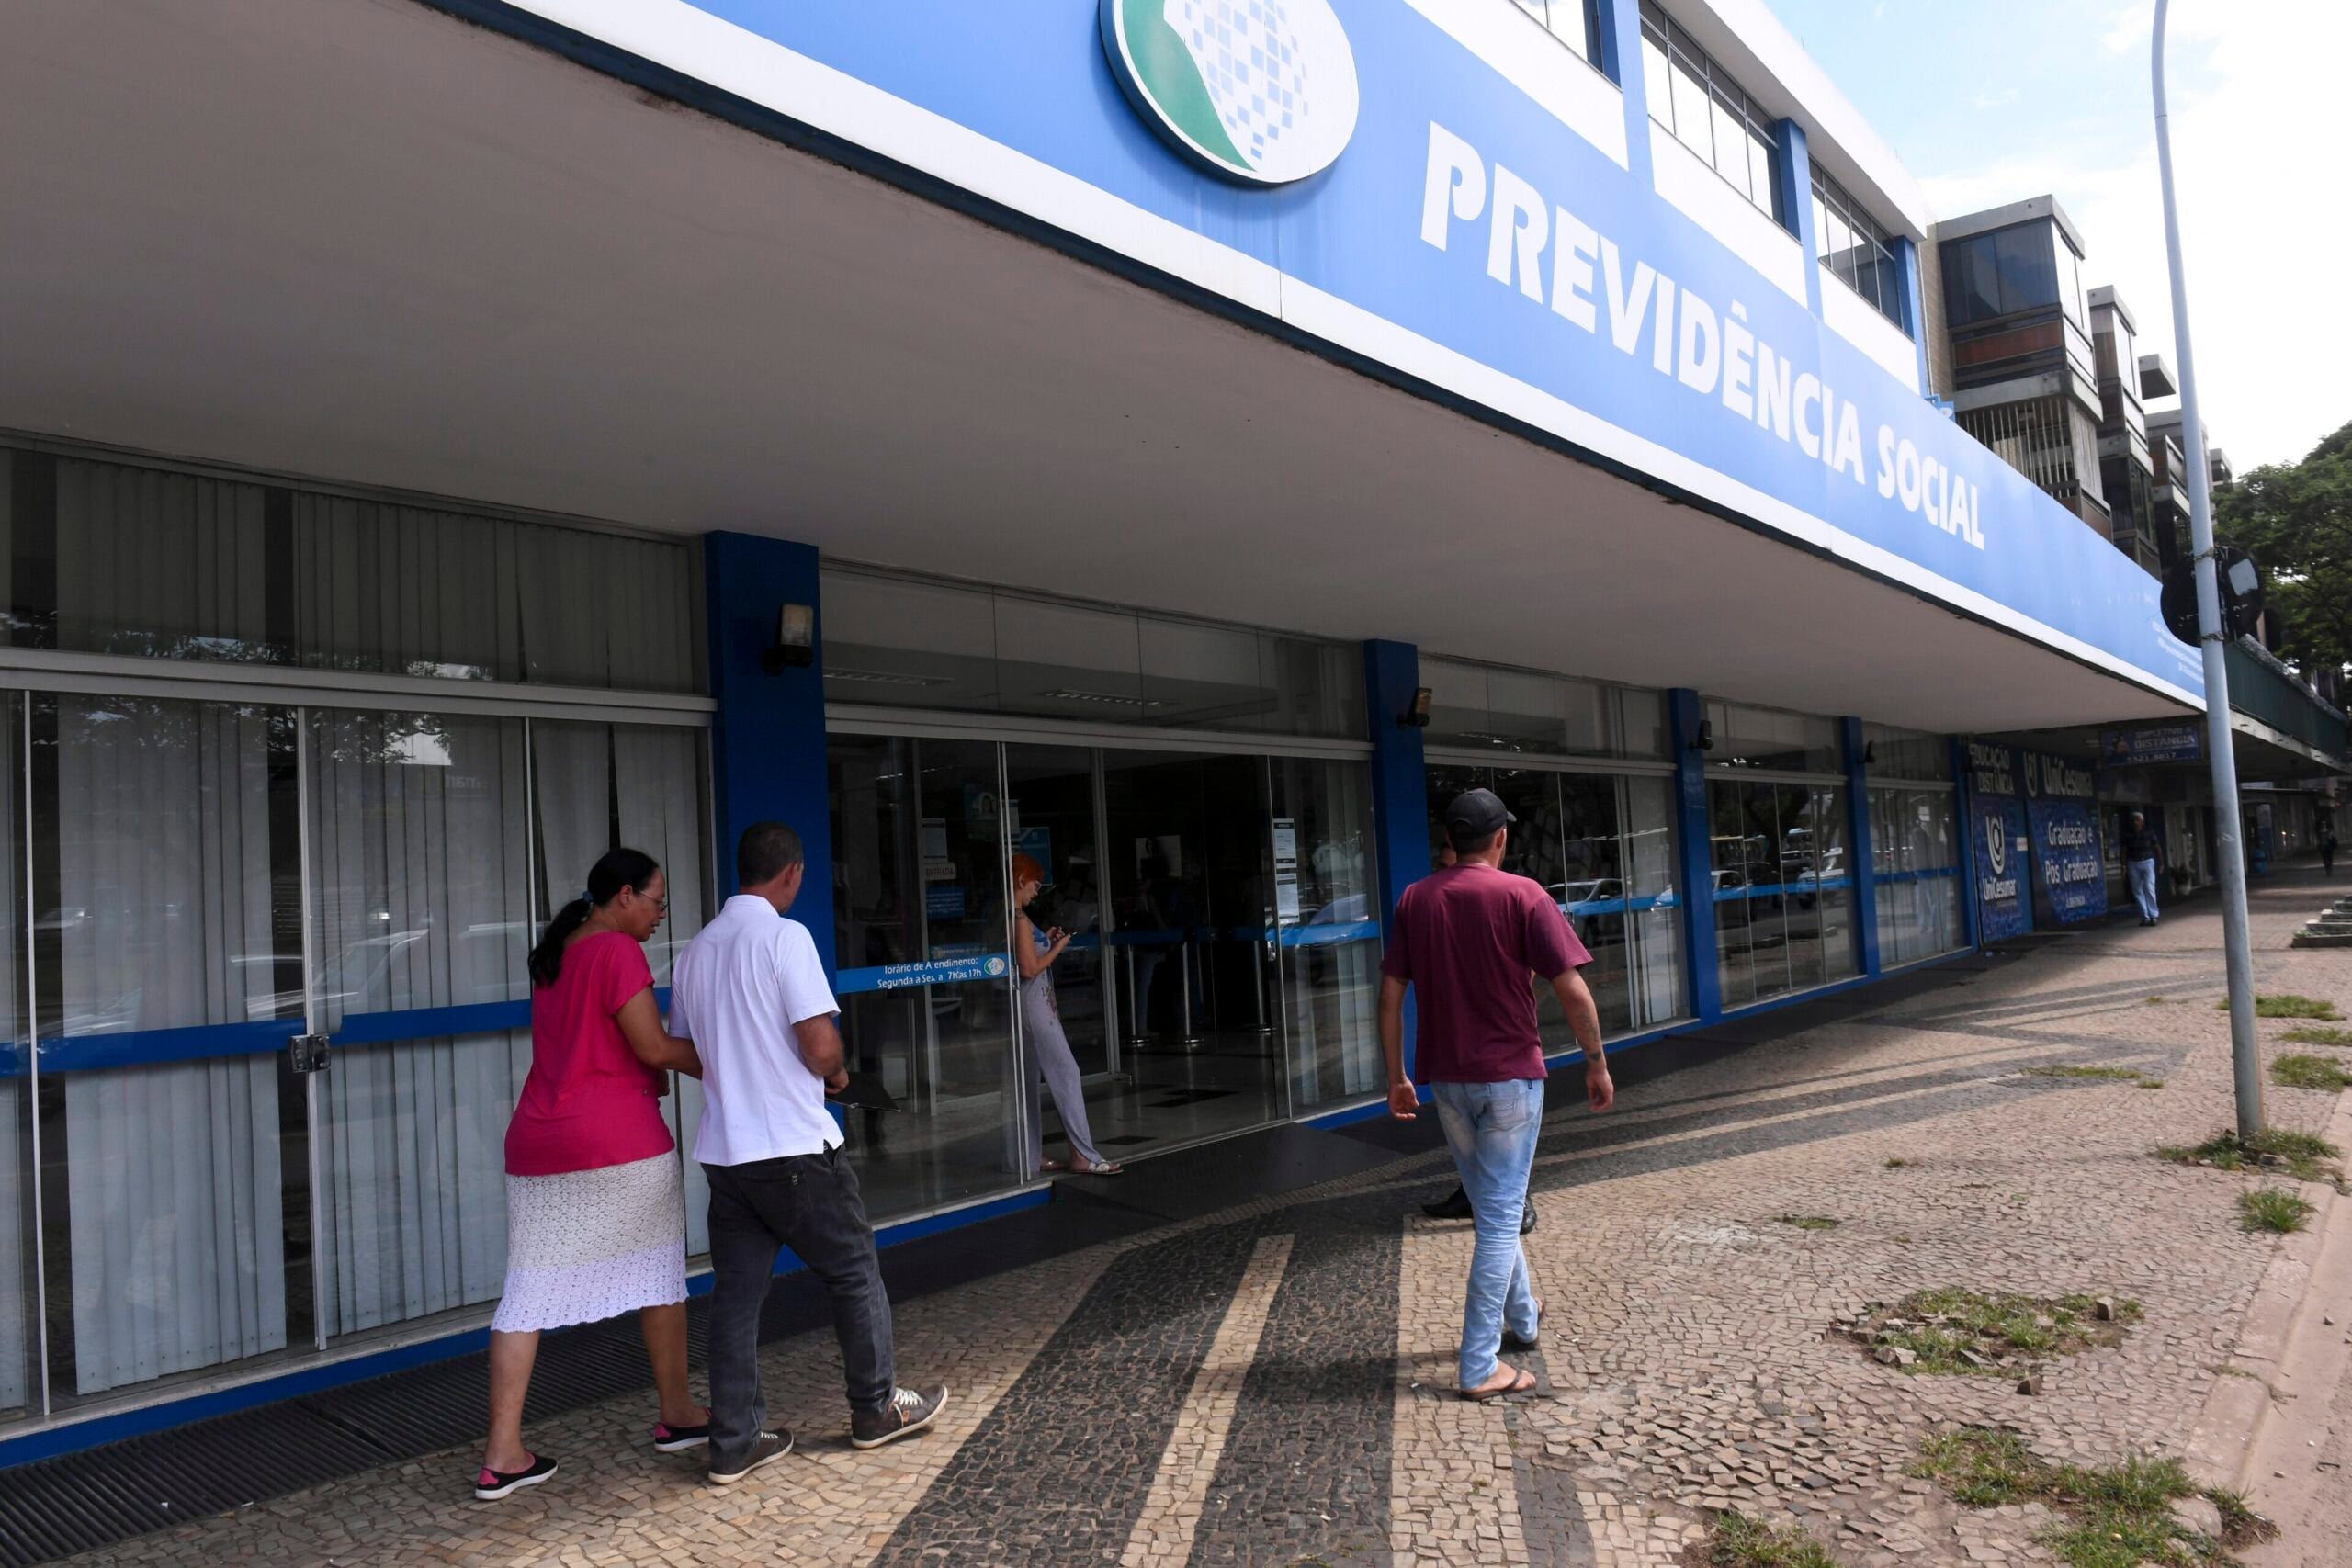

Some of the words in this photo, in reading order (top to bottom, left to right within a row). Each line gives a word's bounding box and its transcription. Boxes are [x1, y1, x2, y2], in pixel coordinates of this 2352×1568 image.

[1420, 120, 1866, 484] PREVIDÊNCIA
[1877, 425, 1984, 549] SOCIAL
[2048, 820, 2086, 850] Graduação
[2045, 858, 2060, 884] Pós
[2063, 855, 2098, 883] Graduação
[877, 976, 913, 990] Segunda
[968, 968, 982, 977] 17h
[913, 963, 923, 972] de
